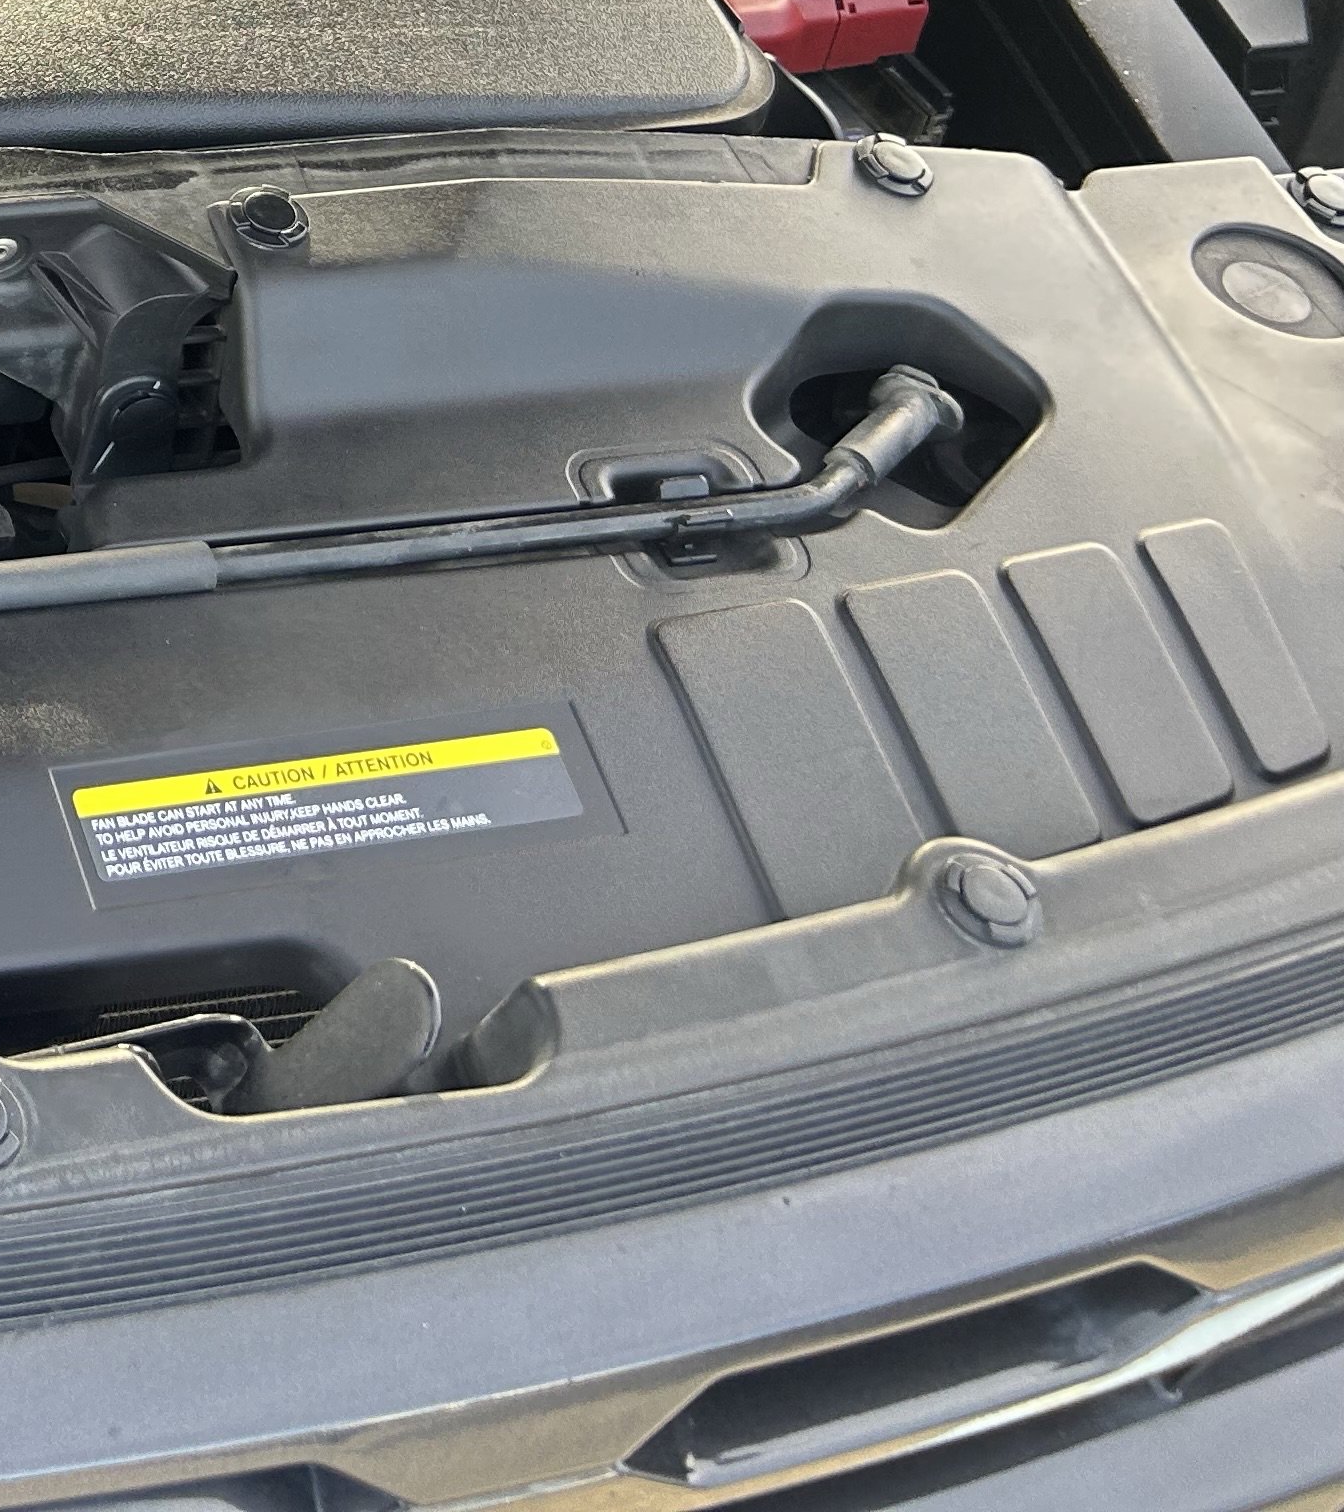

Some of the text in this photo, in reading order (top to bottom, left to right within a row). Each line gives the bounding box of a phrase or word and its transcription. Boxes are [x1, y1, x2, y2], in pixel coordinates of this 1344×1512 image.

[233, 766, 315, 790] CAUTION
[336, 751, 434, 778] ATTENTION
[91, 793, 296, 831] FAN BLADE CAN START AT ANY TIME.
[95, 833, 114, 846] TO
[115, 828, 146, 843] HELP
[149, 823, 184, 839] AVOID
[186, 816, 250, 833] PERSONAL
[322, 799, 364, 815] HANDS
[365, 793, 407, 808] CLEAR.
[101, 807, 425, 862] LE VENTILATEUR RISQUE DE DÉMARRER À TOUT MOMENT.
[105, 813, 491, 878] POUR ÉVITER TOUTE BLESSURE, NE PAS EN APPROCHER LES MAINS.
